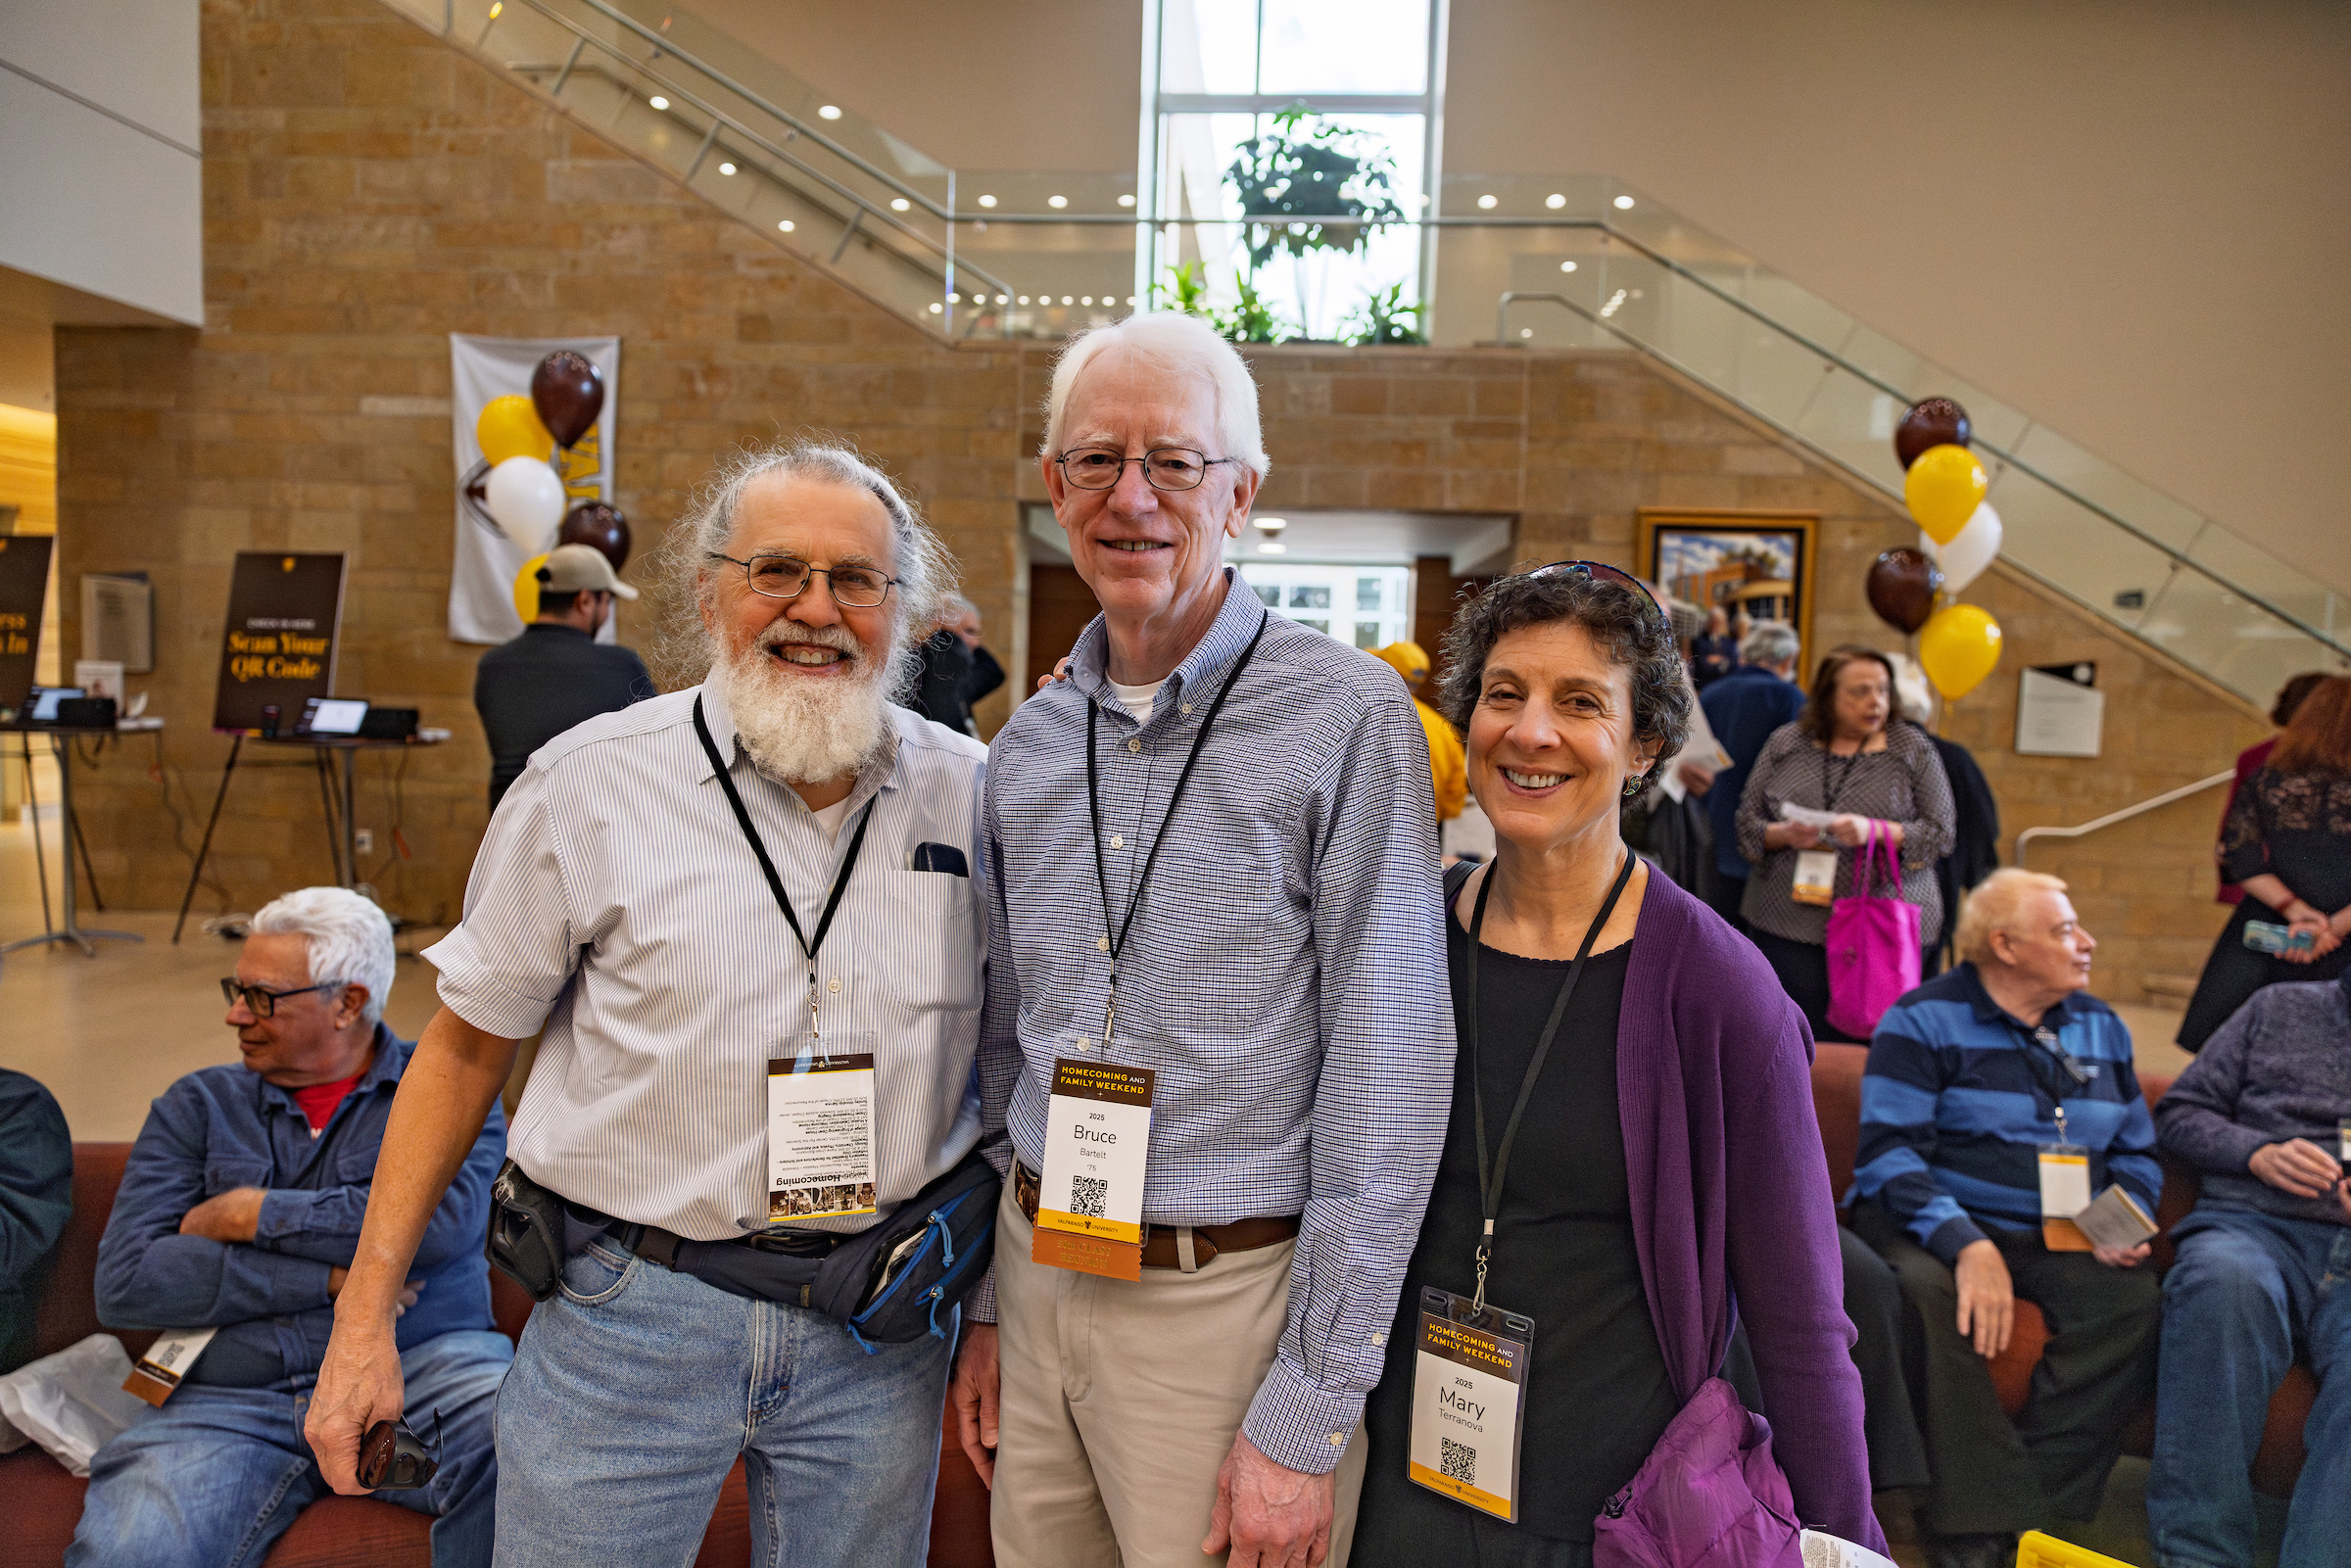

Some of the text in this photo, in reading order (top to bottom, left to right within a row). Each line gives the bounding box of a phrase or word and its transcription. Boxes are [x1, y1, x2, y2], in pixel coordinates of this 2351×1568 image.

[231, 654, 264, 683] QR
[1062, 1066, 1128, 1081] HOMECOMING
[1060, 1076, 1145, 1094] FAMILY WEEKEND
[1088, 1113, 1105, 1121] 2025
[1074, 1125, 1117, 1144] Bruce
[1080, 1148, 1107, 1159] Bartelt
[777, 1174, 840, 1186] Homecoming
[1057, 1218, 1119, 1233] VALPARAISO UNIVERSITY
[1080, 1243, 1111, 1257] CLASS
[1060, 1252, 1107, 1269] REUNION
[1428, 1323, 1513, 1357] HOMECOMING AND
[1427, 1334, 1512, 1368] FAMILY WEEKEND
[1455, 1377, 1472, 1389] 2025
[1440, 1386, 1485, 1421] Mary
[1439, 1407, 1483, 1433] Terranova
[1428, 1475, 1489, 1504] VALPARAISO UNIVERSITY
